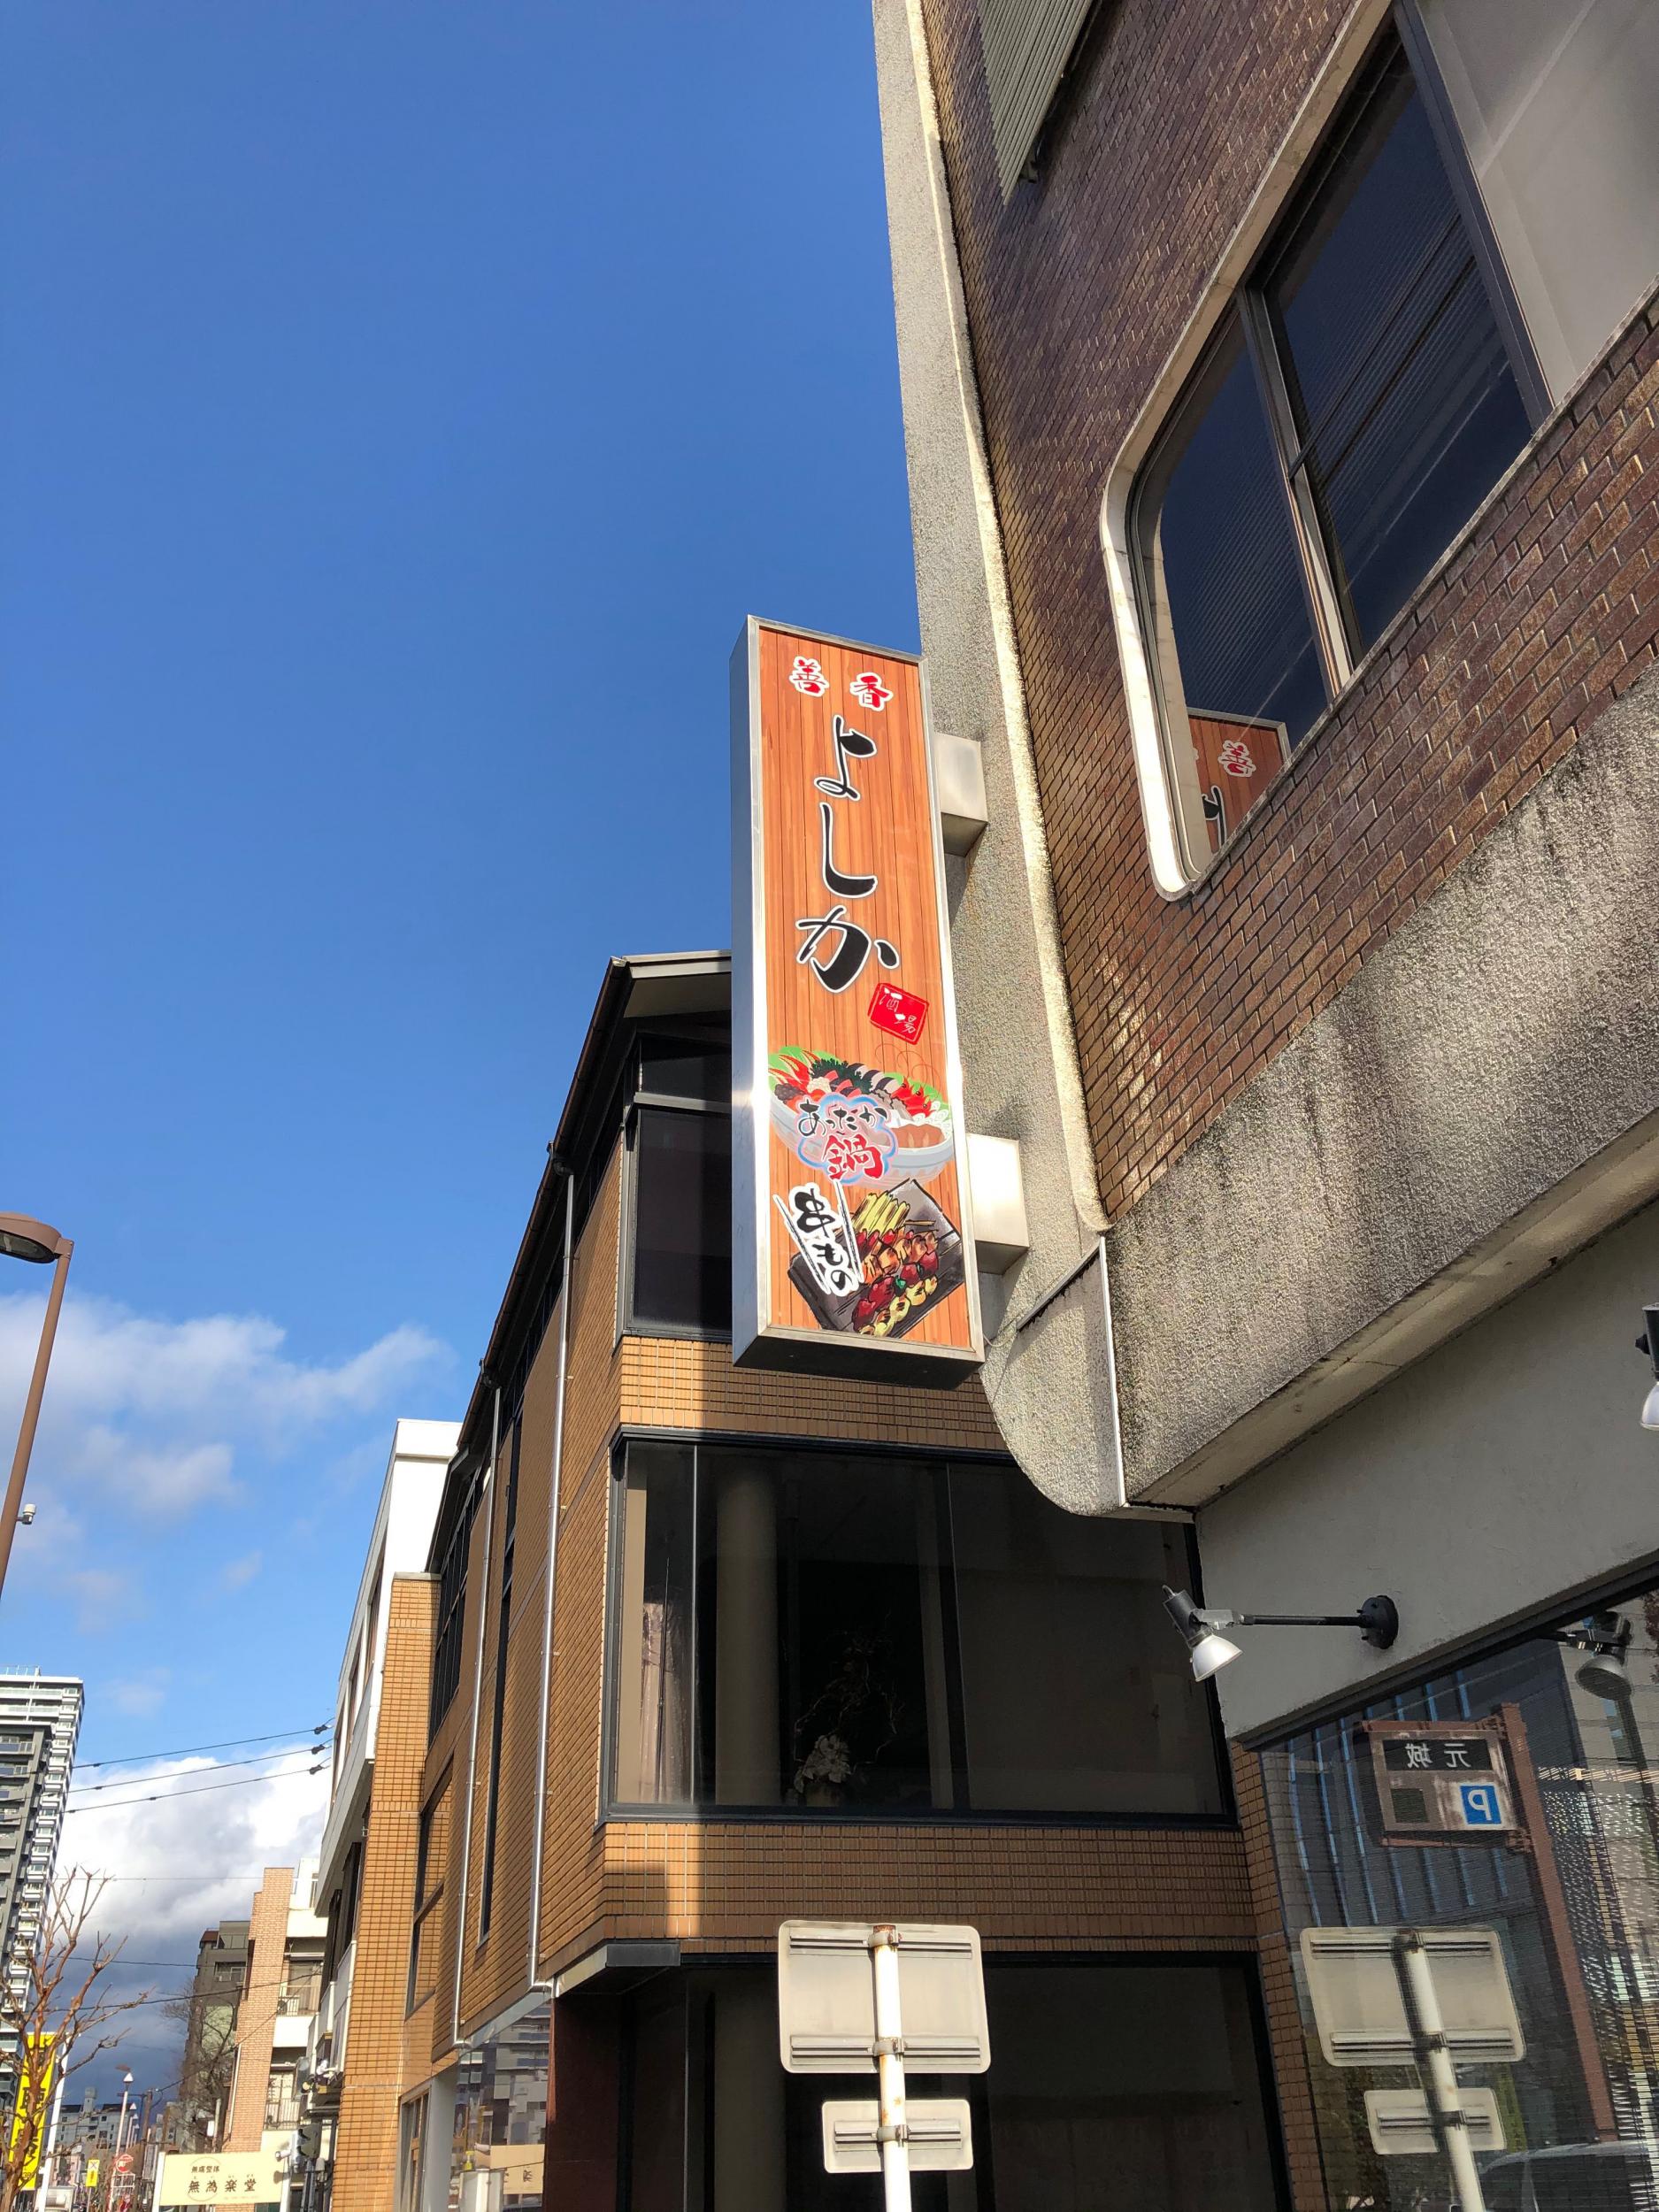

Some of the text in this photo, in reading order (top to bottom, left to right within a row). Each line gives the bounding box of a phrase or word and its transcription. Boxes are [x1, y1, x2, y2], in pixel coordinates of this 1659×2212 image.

[790, 657, 894, 711] 善香
[796, 714, 899, 994] よしか
[879, 987, 917, 1033] 酒場
[798, 1098, 887, 1137] あったか
[822, 1134, 883, 1179] 鍋
[794, 1187, 854, 1291] 串もの
